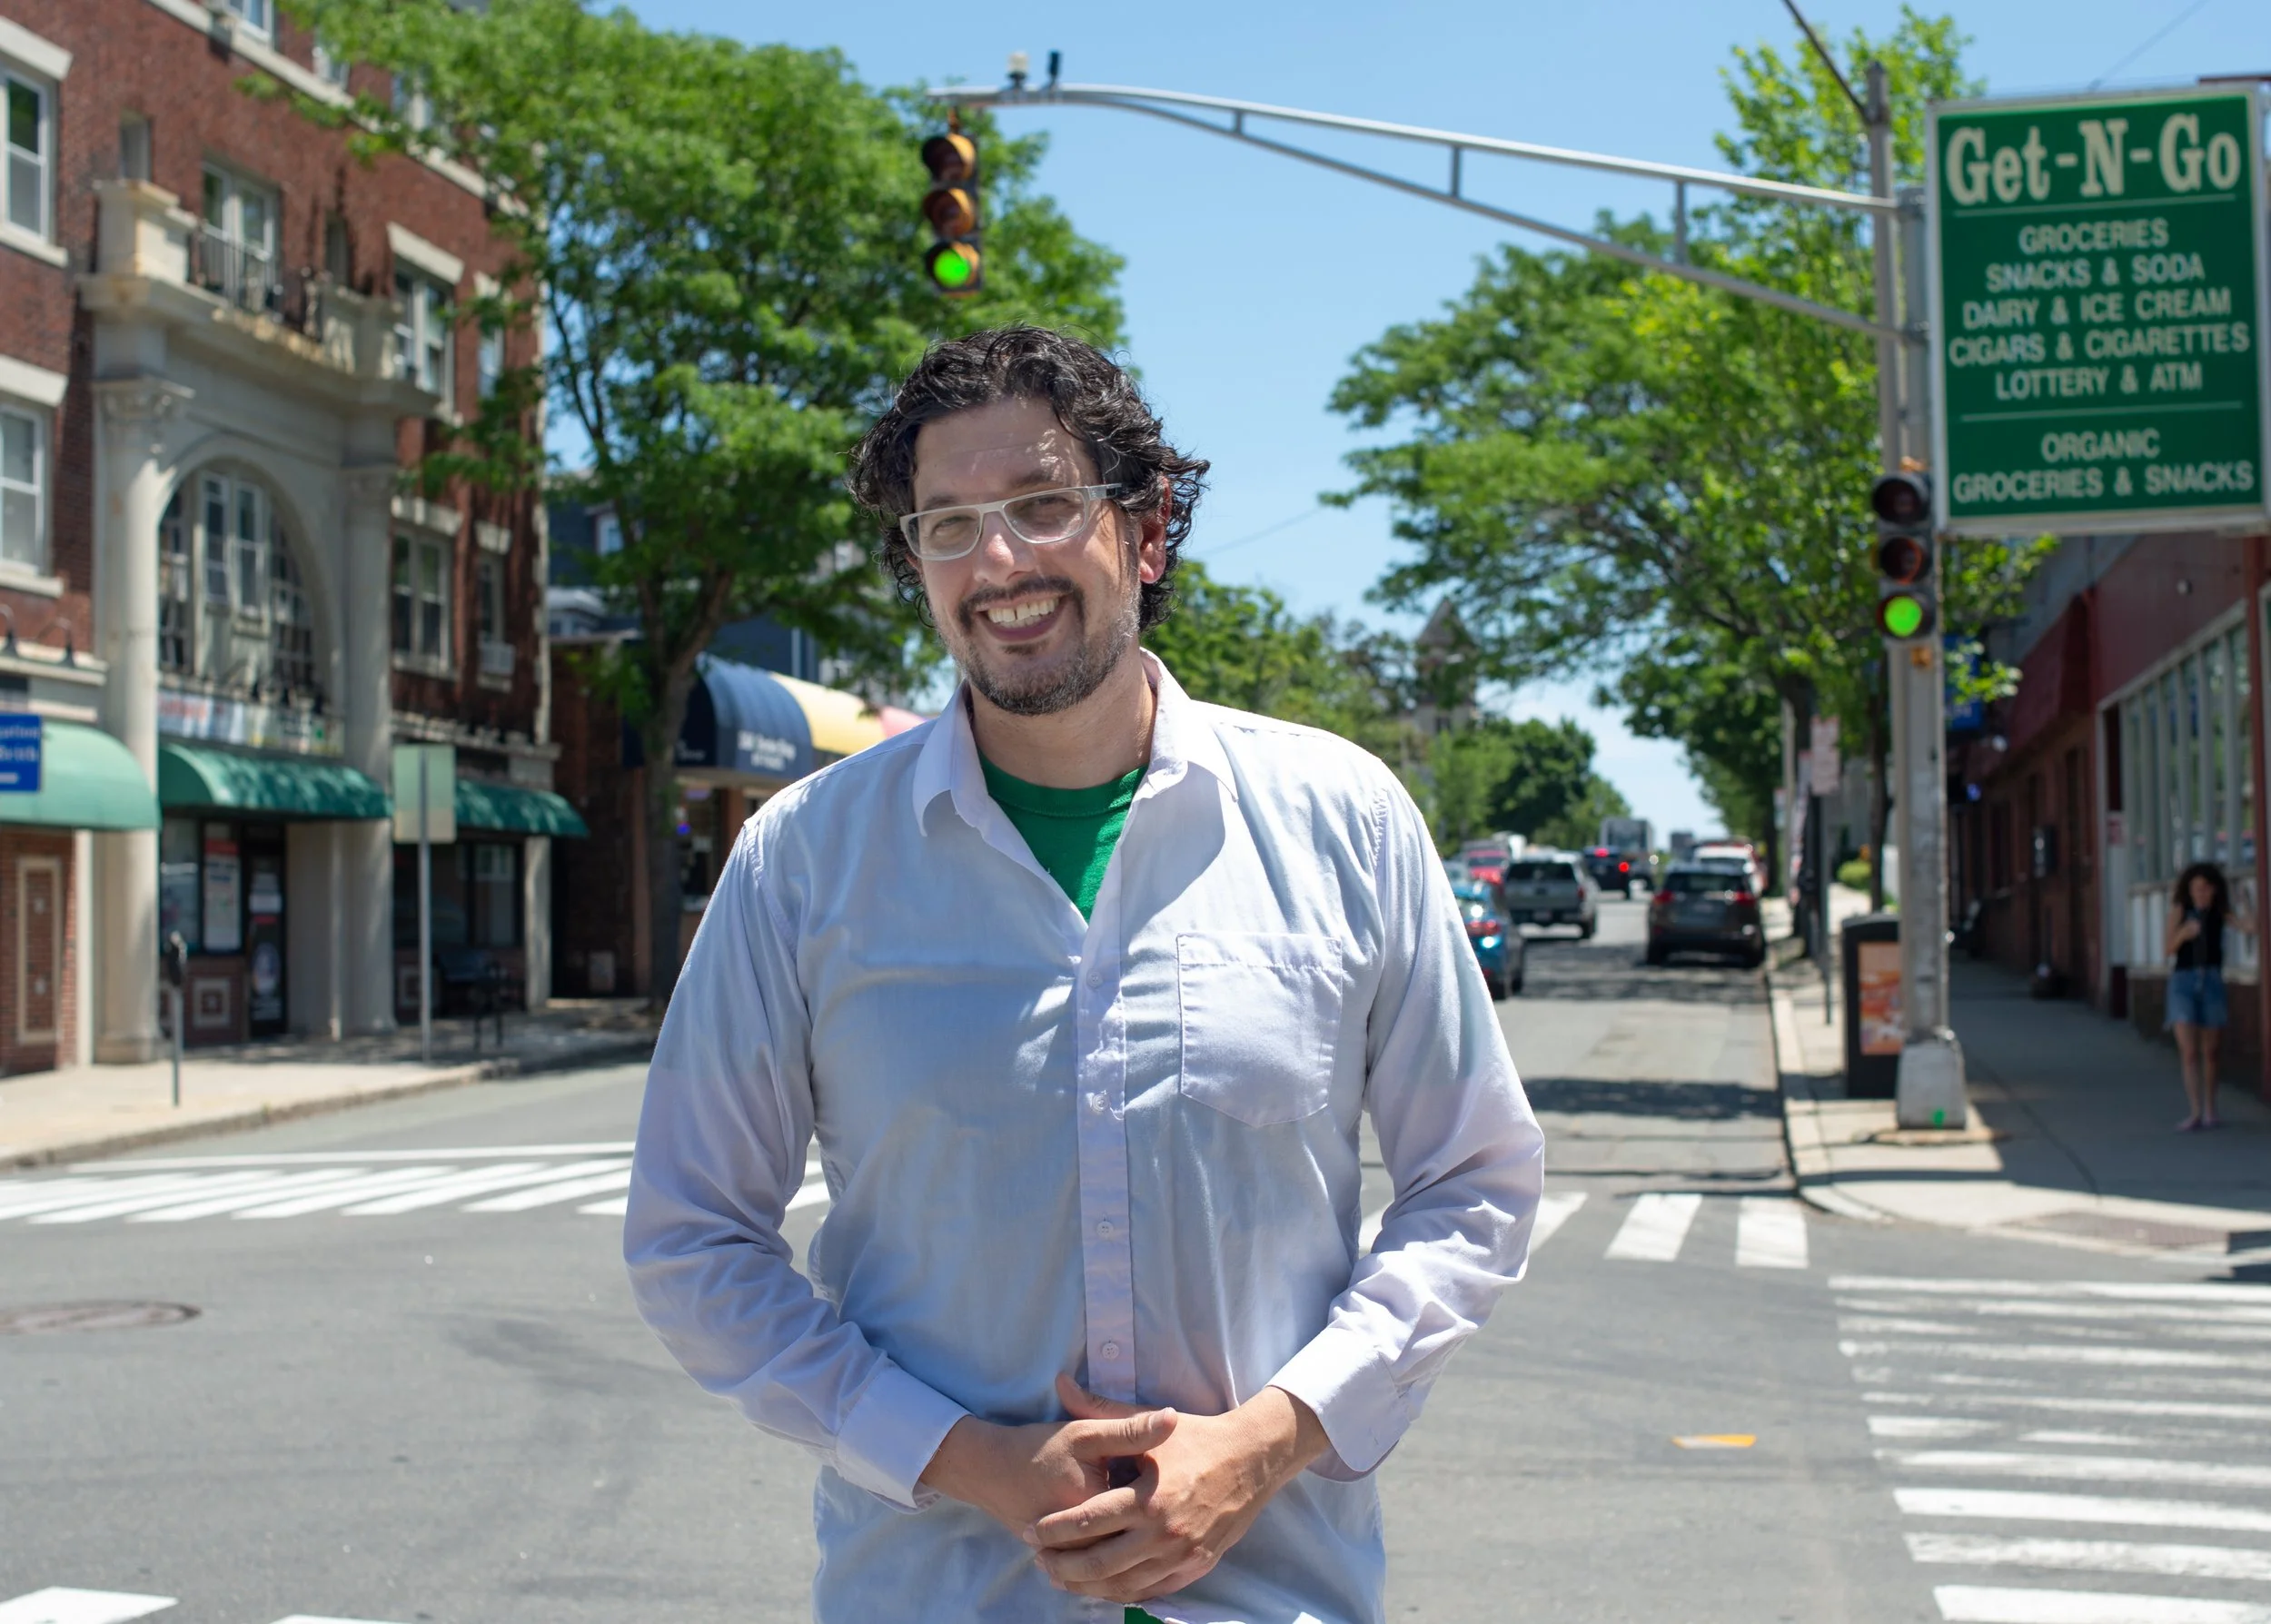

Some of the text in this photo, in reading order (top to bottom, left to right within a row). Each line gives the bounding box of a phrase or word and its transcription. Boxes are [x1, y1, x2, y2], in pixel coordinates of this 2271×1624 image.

[1946, 114, 2241, 205] Get-N-Go
[2019, 218, 2169, 254] GROCERIES
[1987, 253, 2204, 292] SNACKS & SODA
[1964, 288, 2230, 329] DAIRY & ICE CREAM
[1949, 322, 2249, 366] CIGARS & CIGARETTES
[1997, 362, 2201, 399] LOTTERY & ATM
[2042, 430, 2159, 461] ORGANIC
[1953, 461, 2253, 502] GROCERIES & SNACKS
